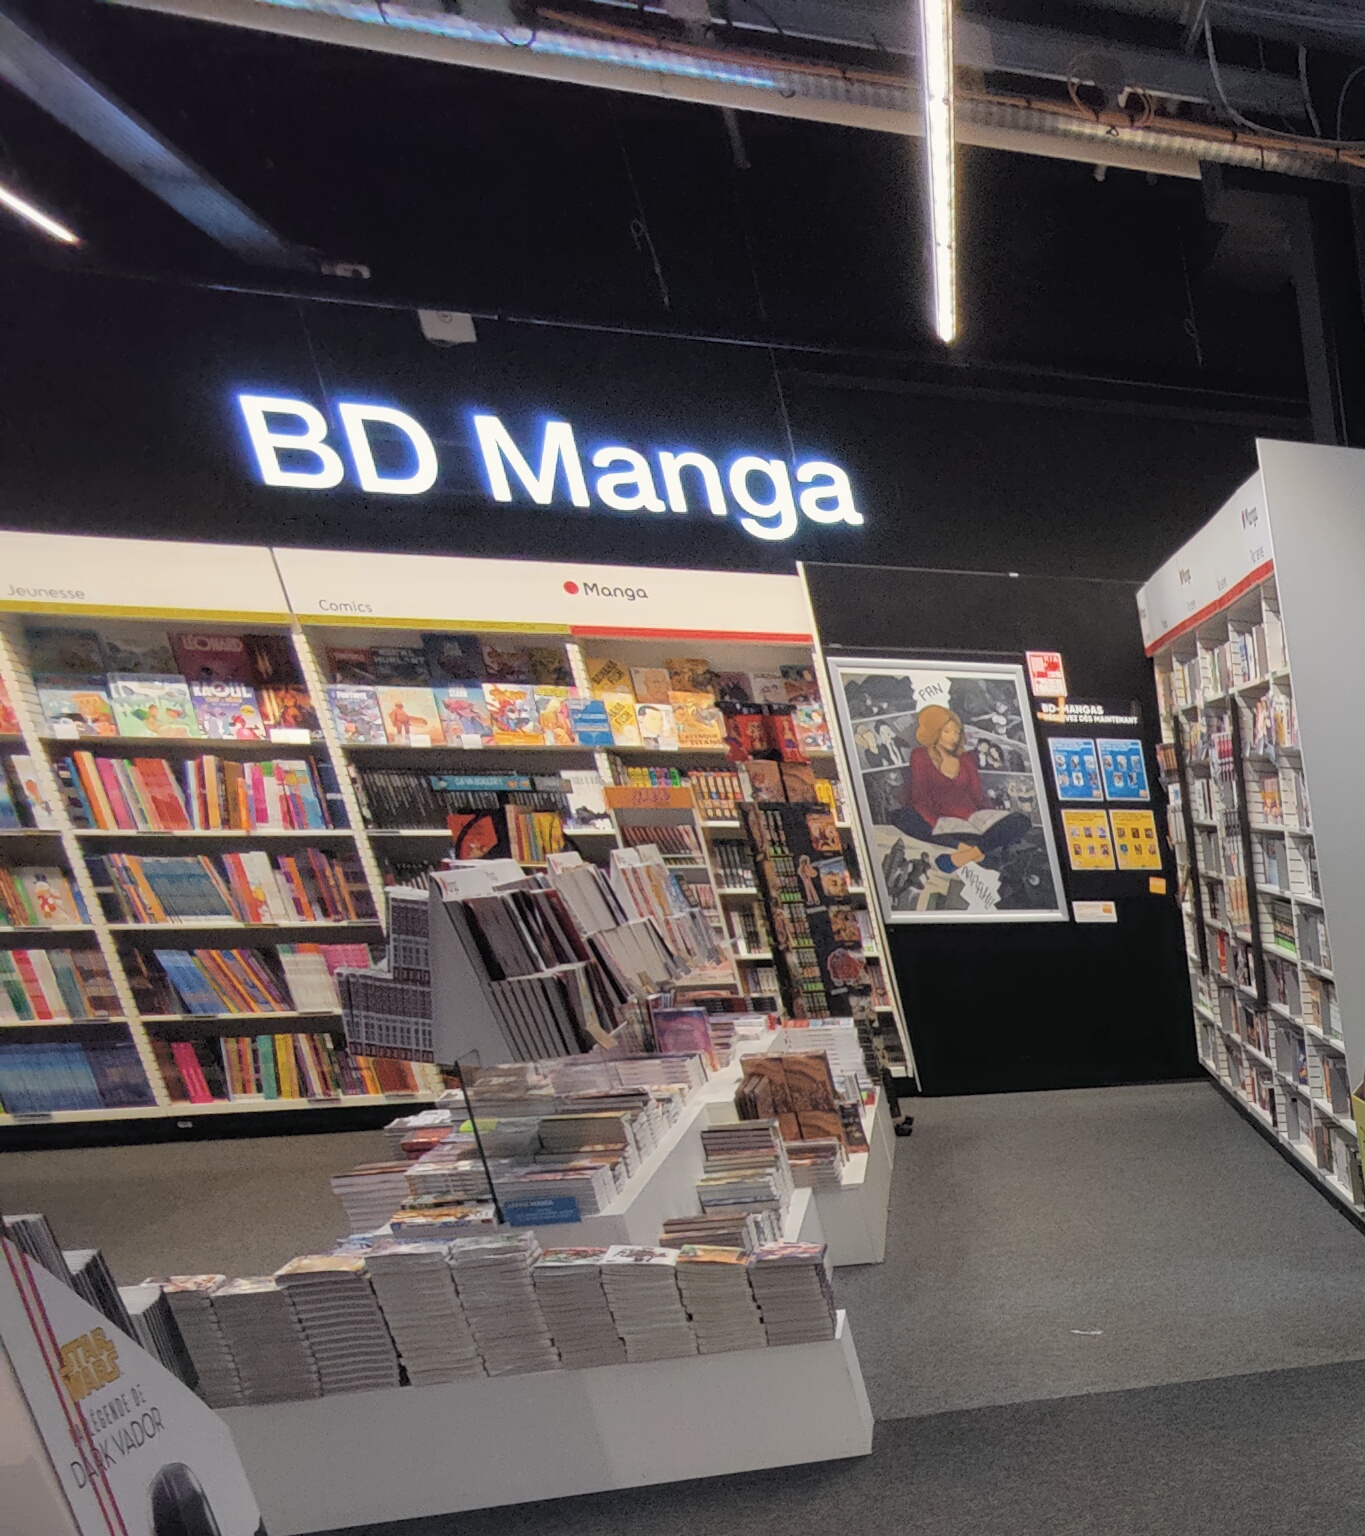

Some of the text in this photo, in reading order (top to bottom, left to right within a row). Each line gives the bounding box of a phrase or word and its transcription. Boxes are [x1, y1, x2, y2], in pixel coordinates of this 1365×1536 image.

[238, 394, 864, 541] BD Manga
[6, 583, 85, 601] Jeunesse
[583, 582, 648, 601] Manga
[318, 598, 373, 613] Comics
[918, 683, 944, 701] PAN
[70, 1407, 165, 1489] DARK VADOR
